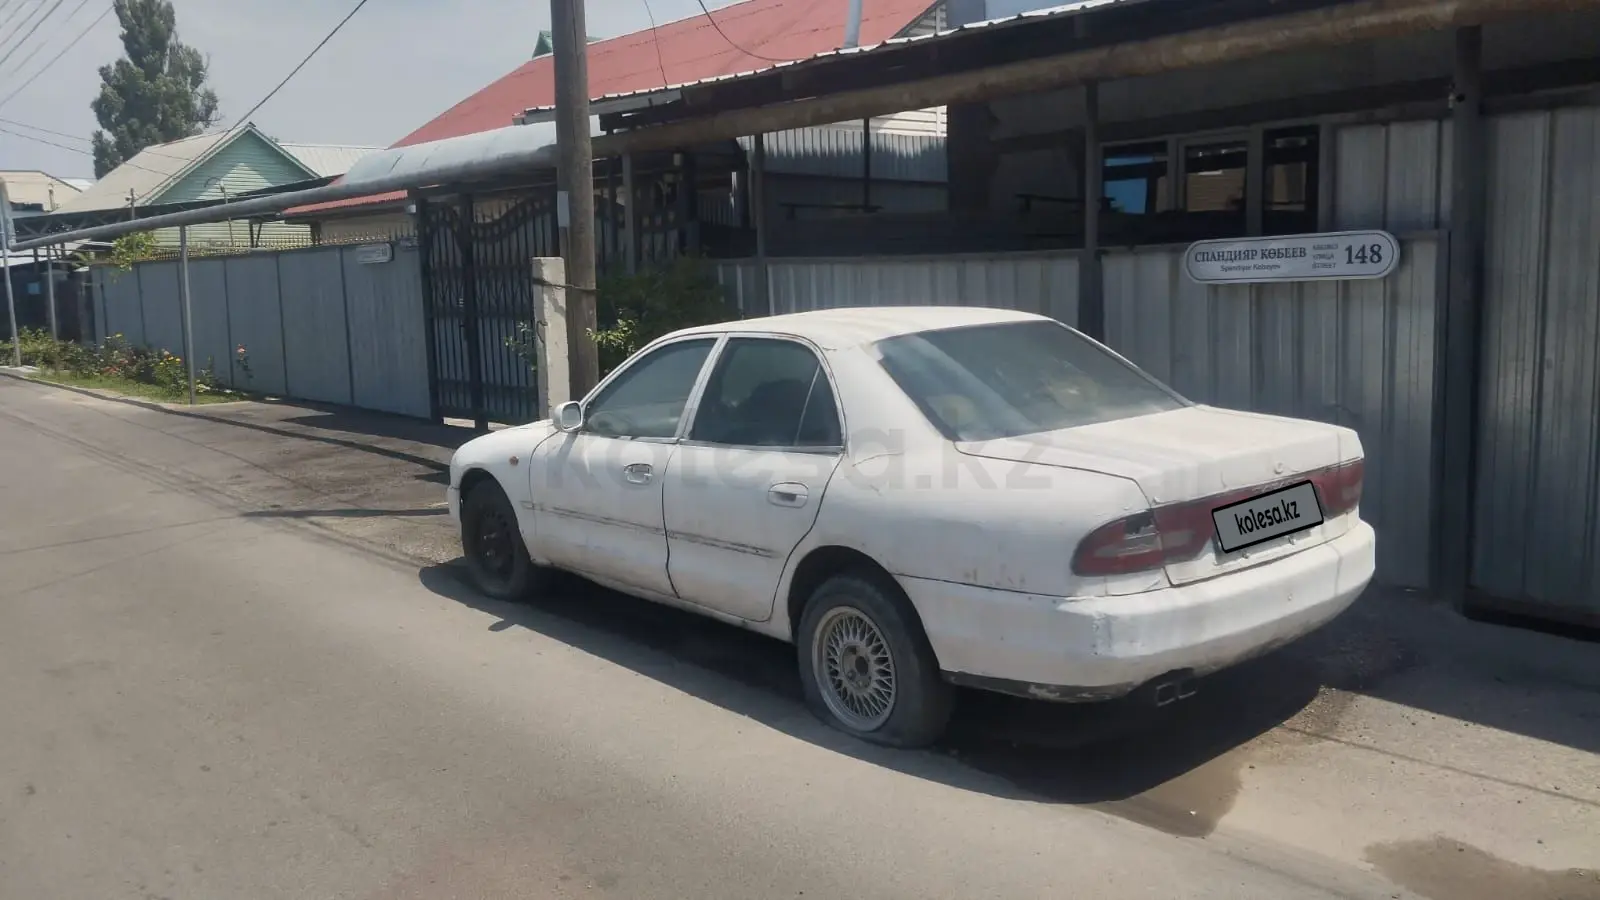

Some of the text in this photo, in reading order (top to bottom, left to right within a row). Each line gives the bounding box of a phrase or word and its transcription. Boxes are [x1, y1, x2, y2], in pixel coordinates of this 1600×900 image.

[1194, 247, 1307, 263] СПАНДИЯР КӨБЕЕВ
[1344, 244, 1383, 264] 148
